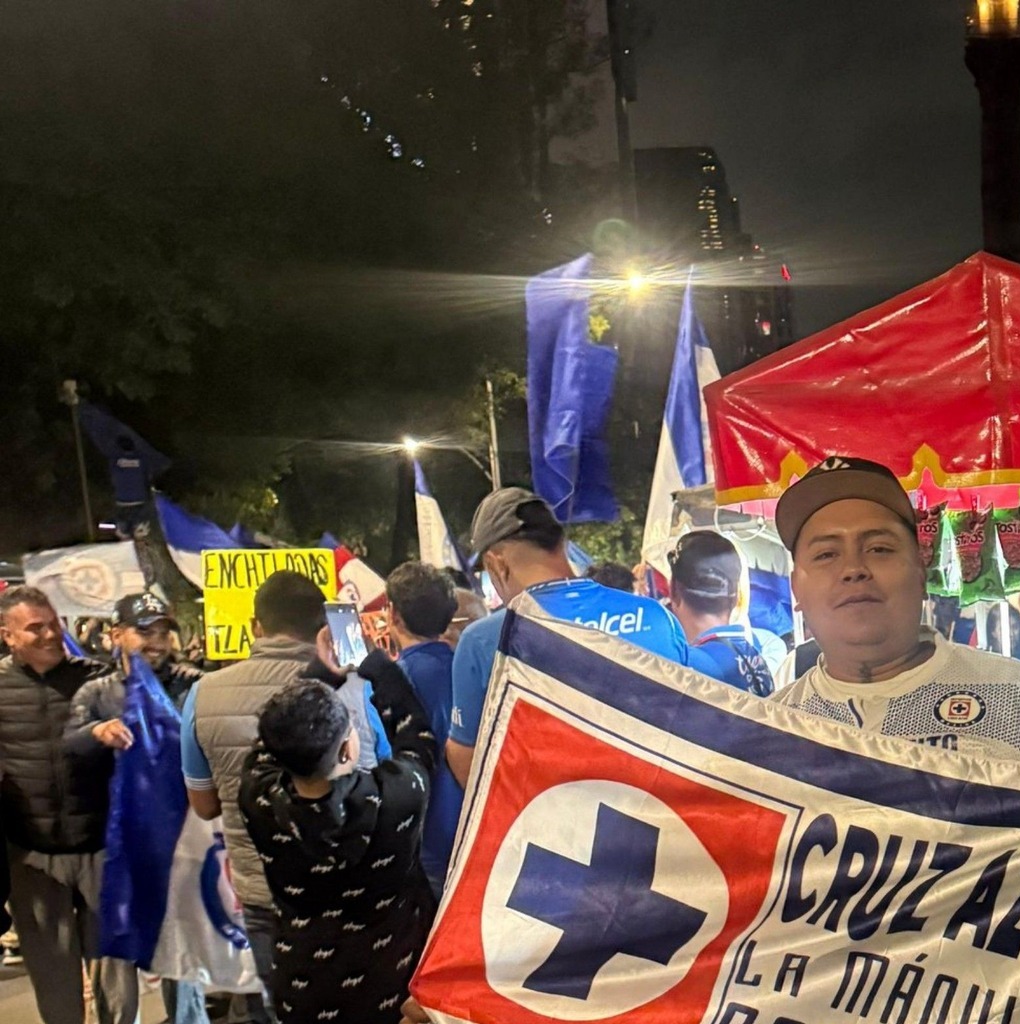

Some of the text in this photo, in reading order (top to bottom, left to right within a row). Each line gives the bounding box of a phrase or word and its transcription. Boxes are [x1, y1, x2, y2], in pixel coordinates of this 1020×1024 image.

[574, 606, 644, 636] lcel
[781, 813, 973, 941] CRUZ
[735, 940, 811, 997] LA
